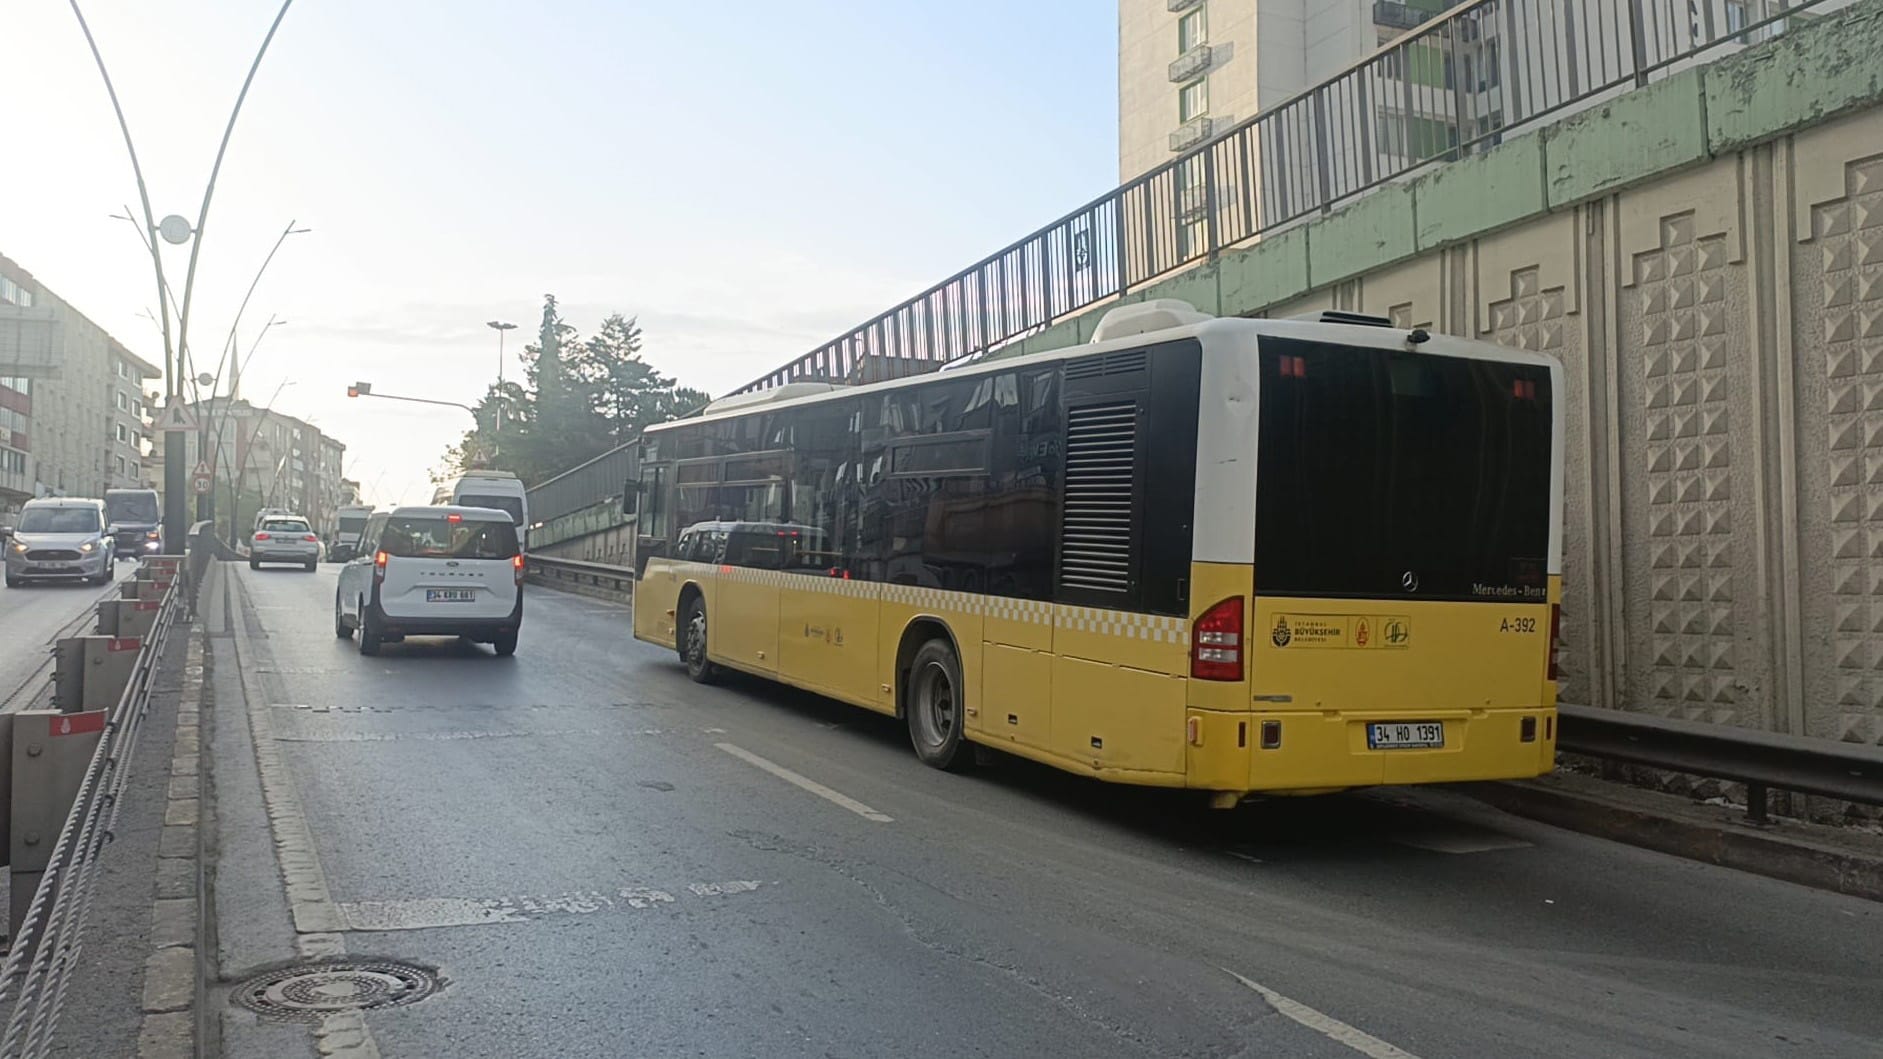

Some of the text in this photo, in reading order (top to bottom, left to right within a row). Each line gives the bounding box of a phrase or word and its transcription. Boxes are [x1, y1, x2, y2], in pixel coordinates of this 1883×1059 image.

[1500, 617, 1536, 633] A-392
[1376, 726, 1389, 741] 34
[1417, 725, 1440, 741] 1391
